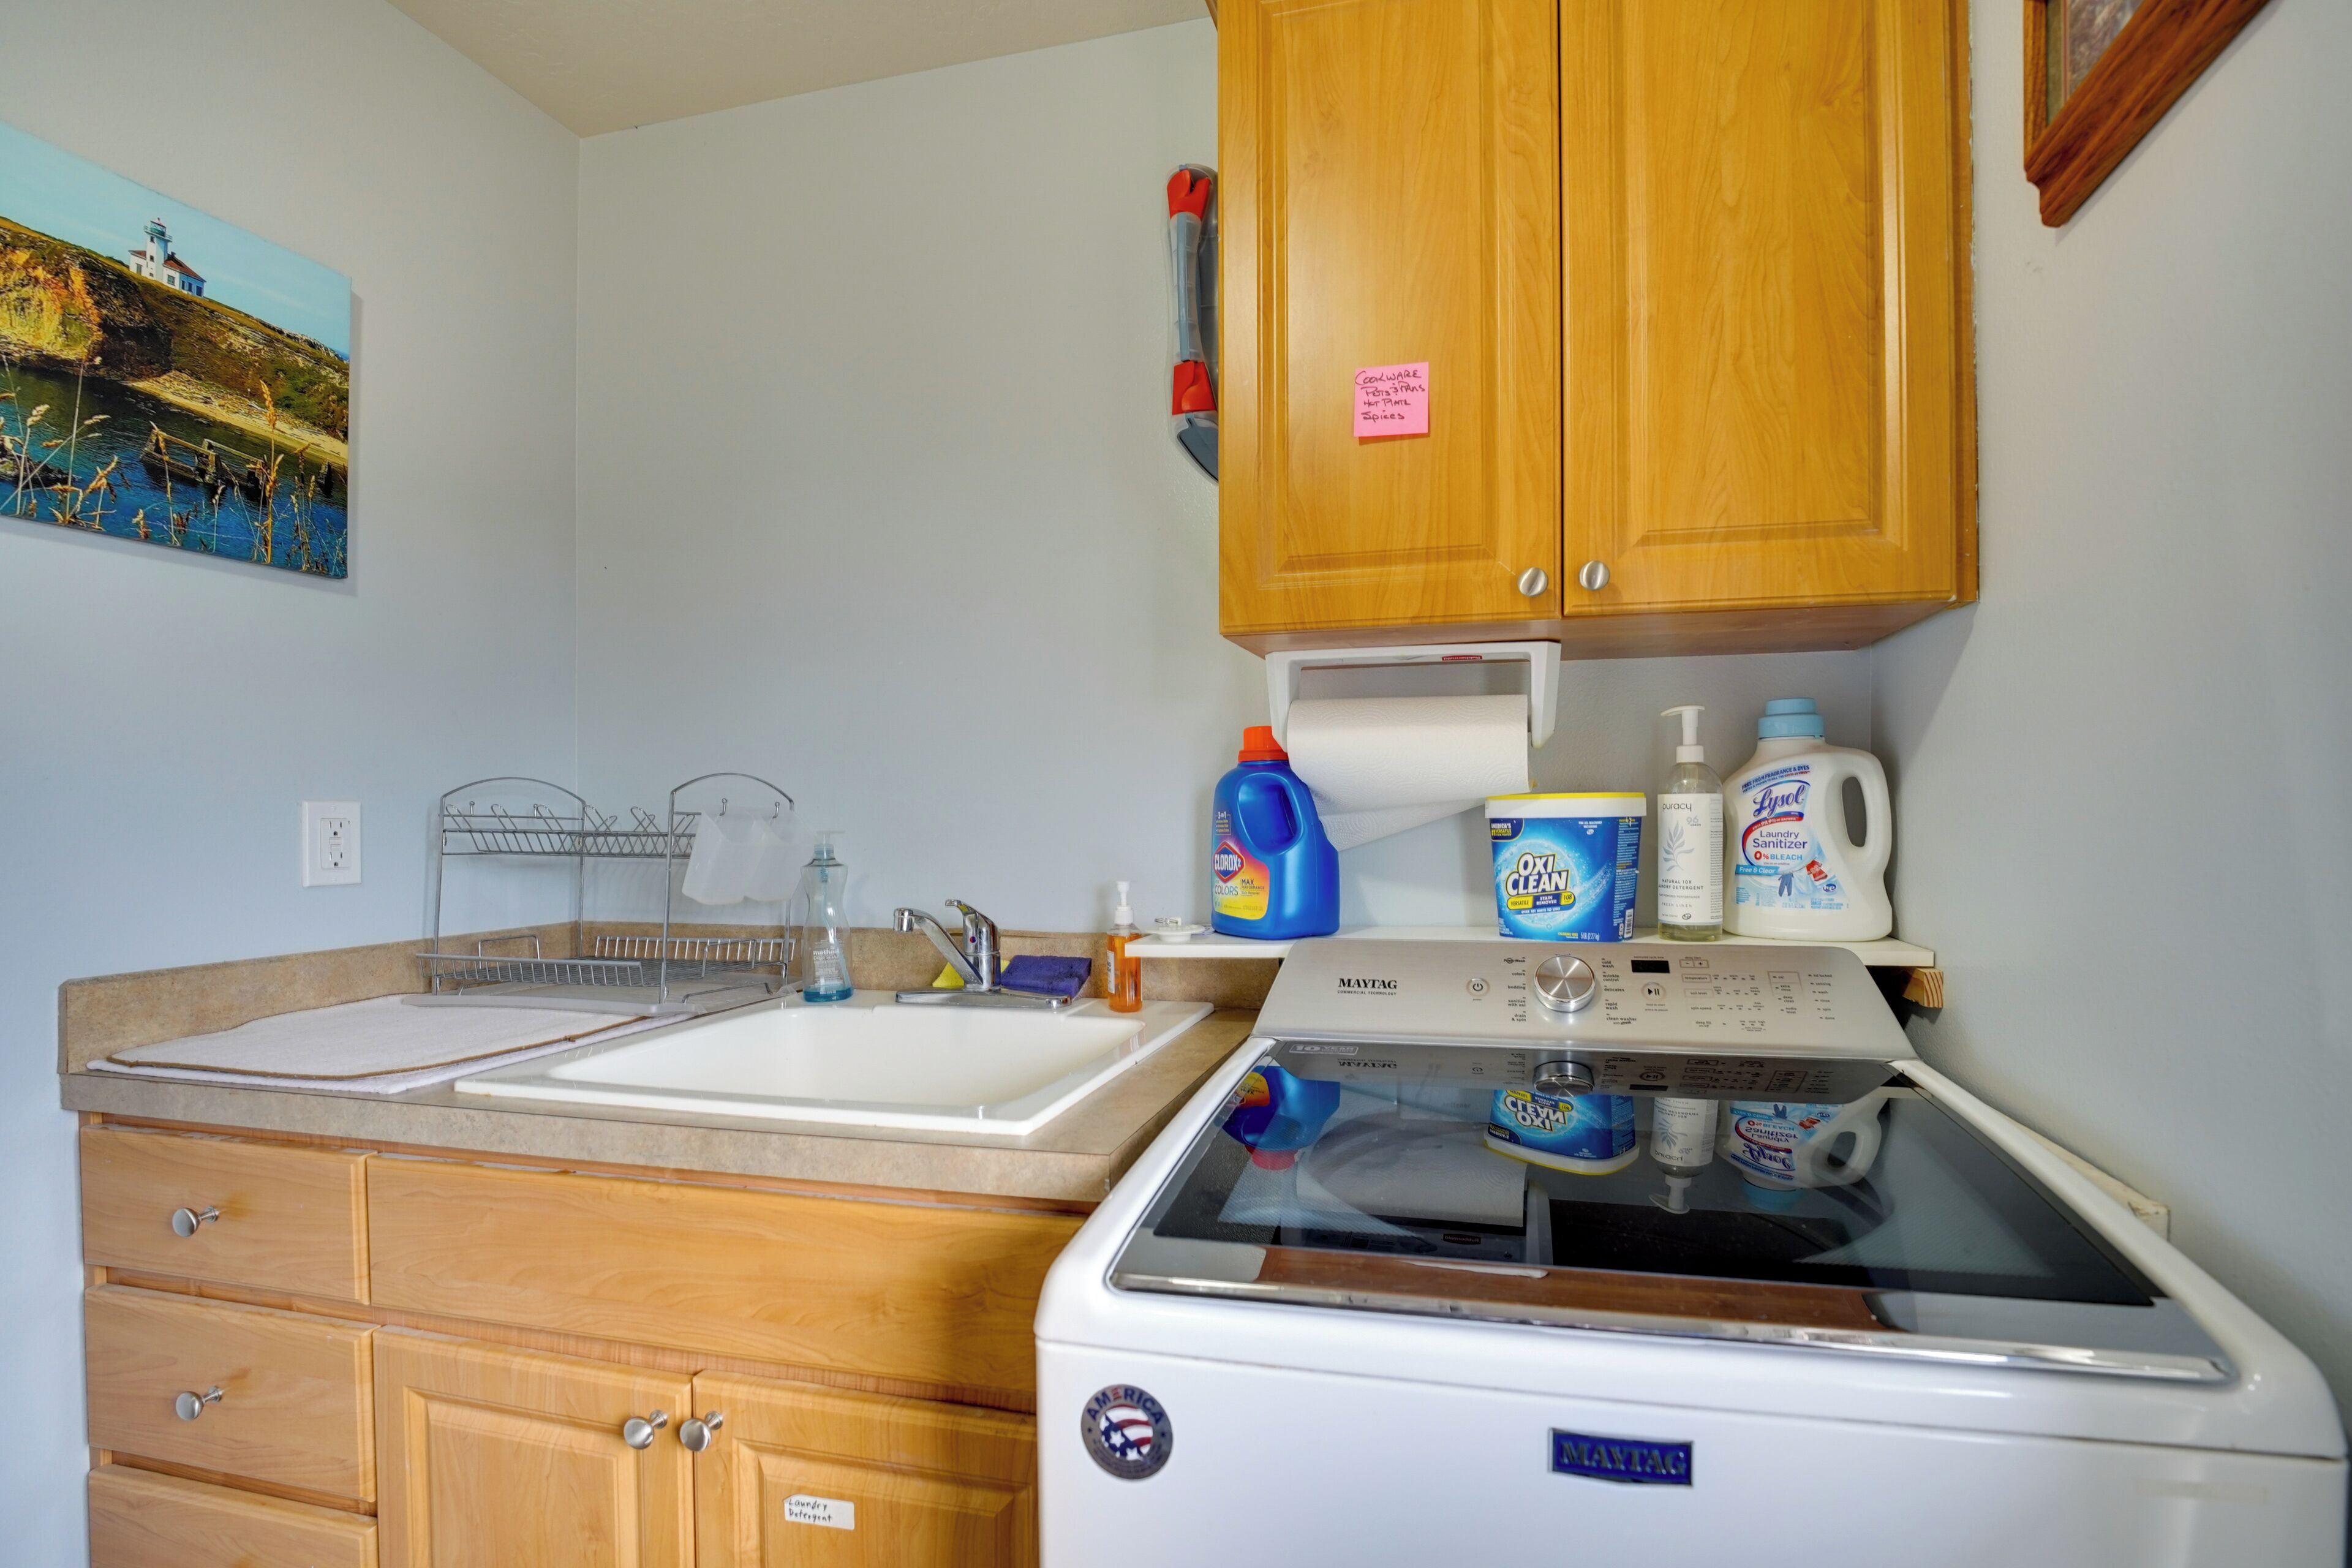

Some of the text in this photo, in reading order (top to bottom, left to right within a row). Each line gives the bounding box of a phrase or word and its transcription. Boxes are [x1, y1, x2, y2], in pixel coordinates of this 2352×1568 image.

[1361, 410, 1405, 423] Spices
[1765, 767, 1792, 779] FRAGRANCE
[1662, 803, 1692, 812] puracy
[1753, 784, 1805, 818] Lysol
[1686, 815, 1699, 824] 96
[1760, 830, 1800, 839] Laundry
[1752, 838, 1807, 849] Sanitizer
[1518, 853, 1555, 876] OXI
[1215, 884, 1238, 896] COLORS
[1506, 870, 1569, 897] CLEAN
[1338, 978, 1398, 989] MAYTAG
[1087, 1387, 1164, 1425] AMERICA
[1560, 1441, 1687, 1476] MAYTAG
[789, 1498, 827, 1512] Laundry
[789, 1507, 832, 1523] Detergent
